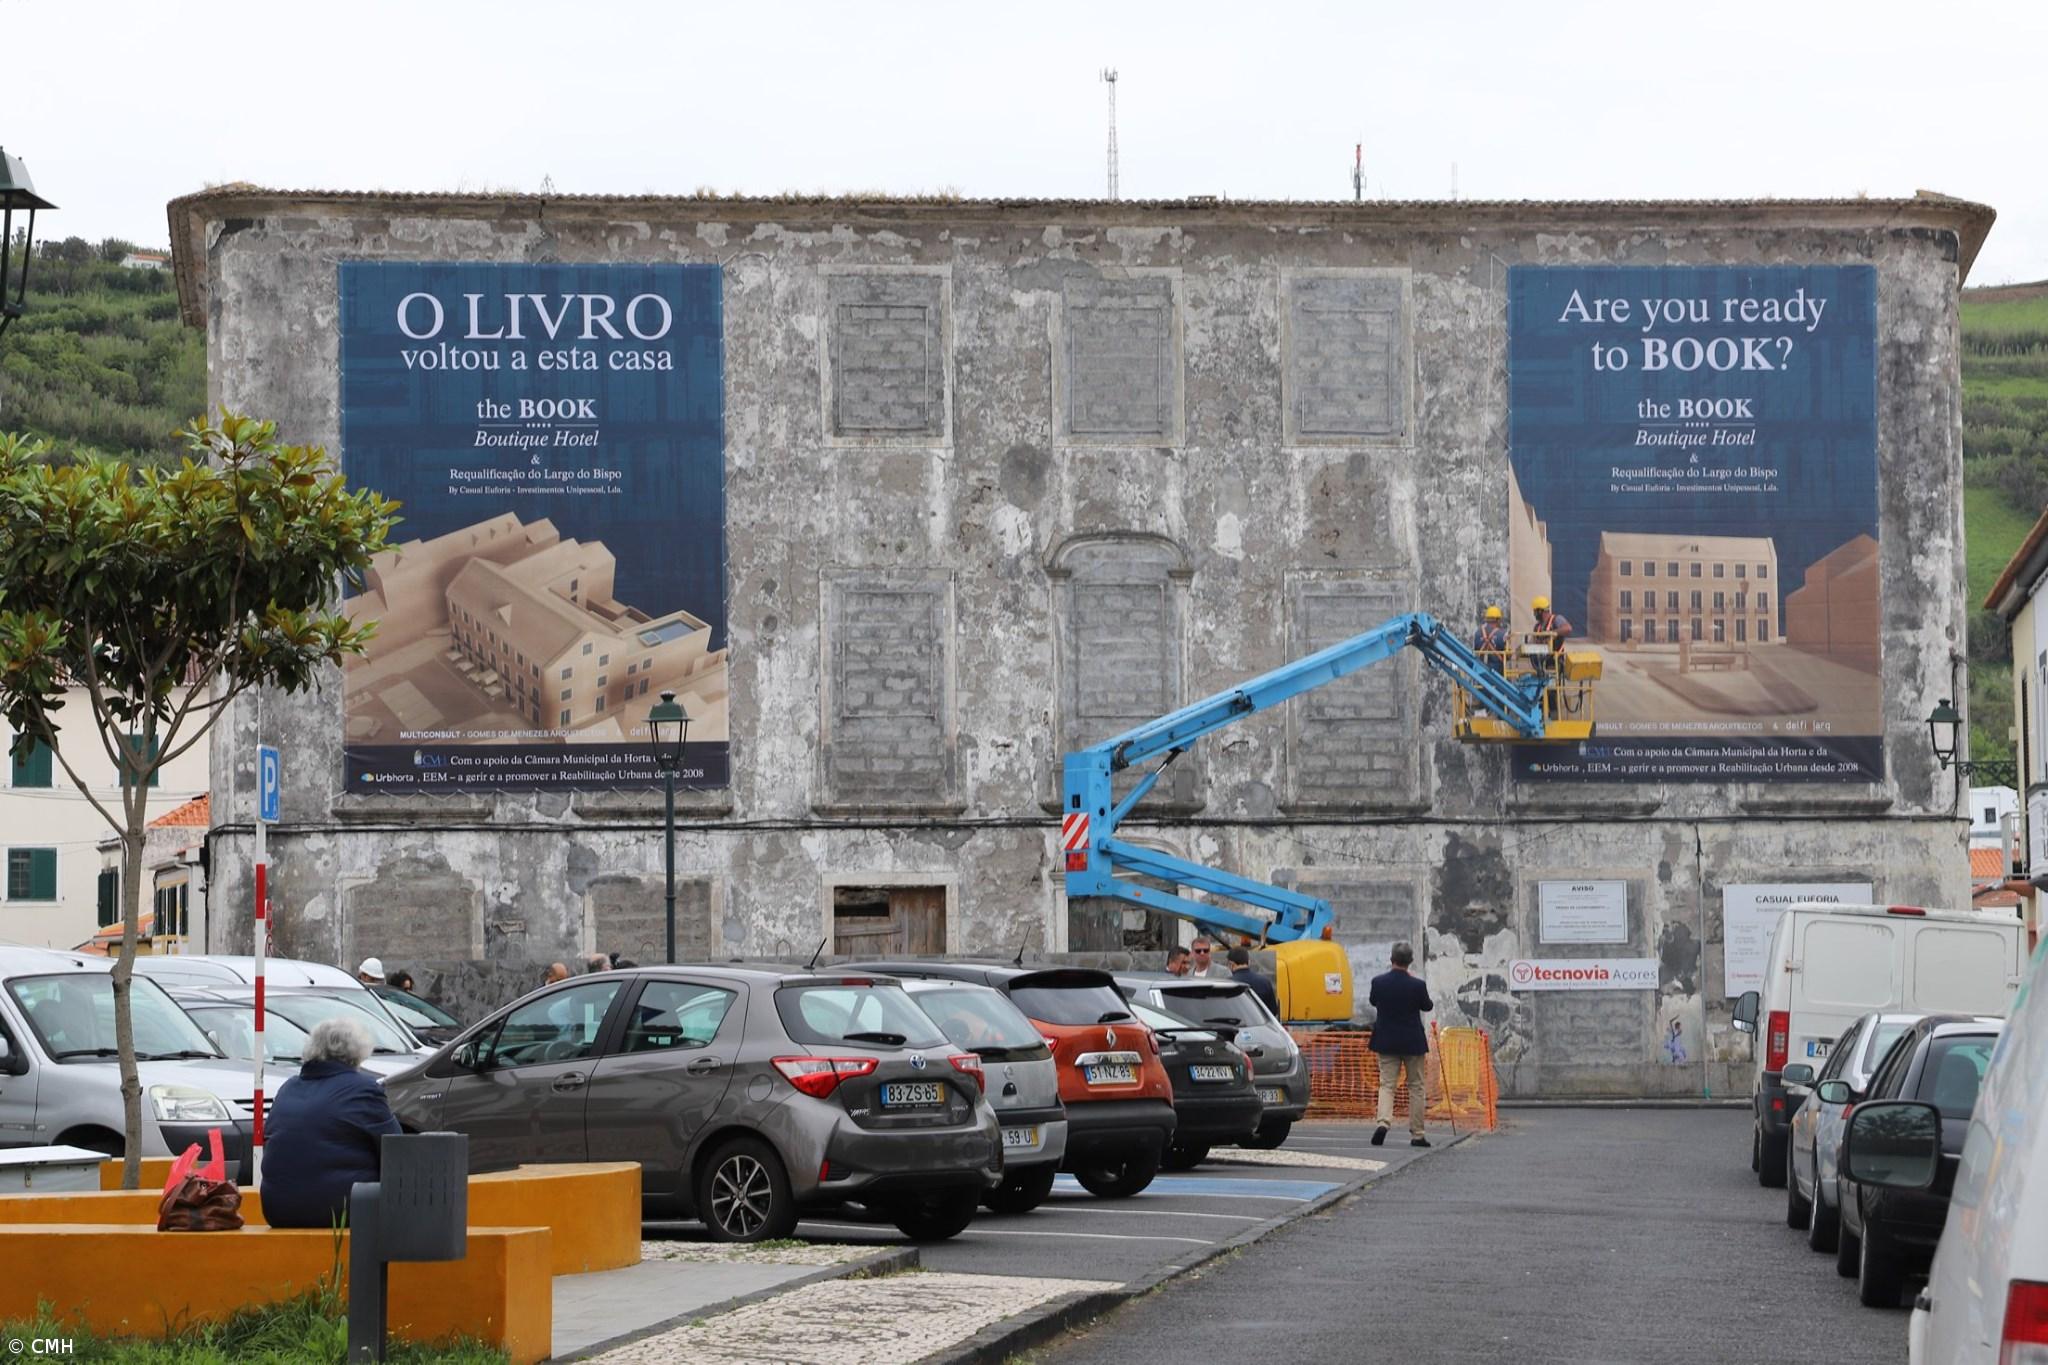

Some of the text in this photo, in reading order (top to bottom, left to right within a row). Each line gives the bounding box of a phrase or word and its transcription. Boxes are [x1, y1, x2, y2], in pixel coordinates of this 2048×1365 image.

[396, 292, 673, 340] O LIVRO
[1558, 288, 1827, 332] Are you ready
[400, 342, 674, 371] voltou a esta casa
[1591, 336, 1793, 371] to BOOK?
[476, 399, 597, 419] the BOOK
[1638, 399, 1753, 418] the BOOK
[473, 430, 599, 451] Boutique Hotel
[1635, 429, 1756, 450] Boutique Hotel
[530, 454, 540, 465] &
[1689, 453, 1699, 464] &
[450, 468, 622, 482] Requalificação do Largo do Bispo
[1612, 467, 1778, 481] Requalificação do Largo do Bispo
[449, 486, 458, 495] By
[459, 486, 483, 494] Casual
[485, 486, 510, 494] Euforia
[517, 486, 564, 494] Investimentos
[1621, 484, 1643, 492] Casual
[1676, 484, 1722, 492] Investimentos
[400, 730, 461, 739] MULTICONSULT
[467, 730, 497, 738] GOMES
[450, 755, 472, 765] Com
[475, 757, 481, 765] o
[483, 754, 508, 767] apoio
[511, 754, 522, 765] da
[524, 752, 561, 765] Câmara
[563, 753, 608, 767] Municipal
[610, 754, 622, 764] da
[624, 753, 651, 763] Horta
[1613, 747, 1635, 757] Com
[1636, 749, 1642, 757] o
[1644, 747, 1670, 760] apoio
[1671, 747, 1682, 757] da
[1684, 746, 1719, 757] Câmara
[1721, 747, 1765, 760] Municipal
[1767, 746, 1779, 757] da
[1780, 746, 1807, 757] Horta
[1816, 746, 1828, 756] da
[375, 773, 414, 782] Urbhorta
[423, 772, 448, 782] EEM
[458, 774, 463, 782] a
[465, 772, 487, 783] gerir
[489, 774, 494, 782] e
[498, 773, 505, 781] a
[505, 773, 549, 784] promover
[551, 773, 557, 781] a
[559, 770, 616, 782] Reabilitação
[618, 770, 652, 780] Urbana
[682, 768, 704, 779] 2008
[1542, 763, 1580, 772] Urbhorta
[1587, 762, 1611, 773] EEM
[1628, 763, 1649, 774] gerir
[1666, 764, 1709, 774] promover
[1711, 764, 1717, 772] a
[1719, 762, 1773, 775] Reabilitação
[1775, 762, 1809, 772] Urbana
[1810, 762, 1835, 772] desde
[1837, 762, 1859, 772] 2008
[265, 756, 276, 812] P
[1755, 894, 1840, 904] CASUAL EUFORIA
[1534, 964, 1657, 981] tecnovia Açores
